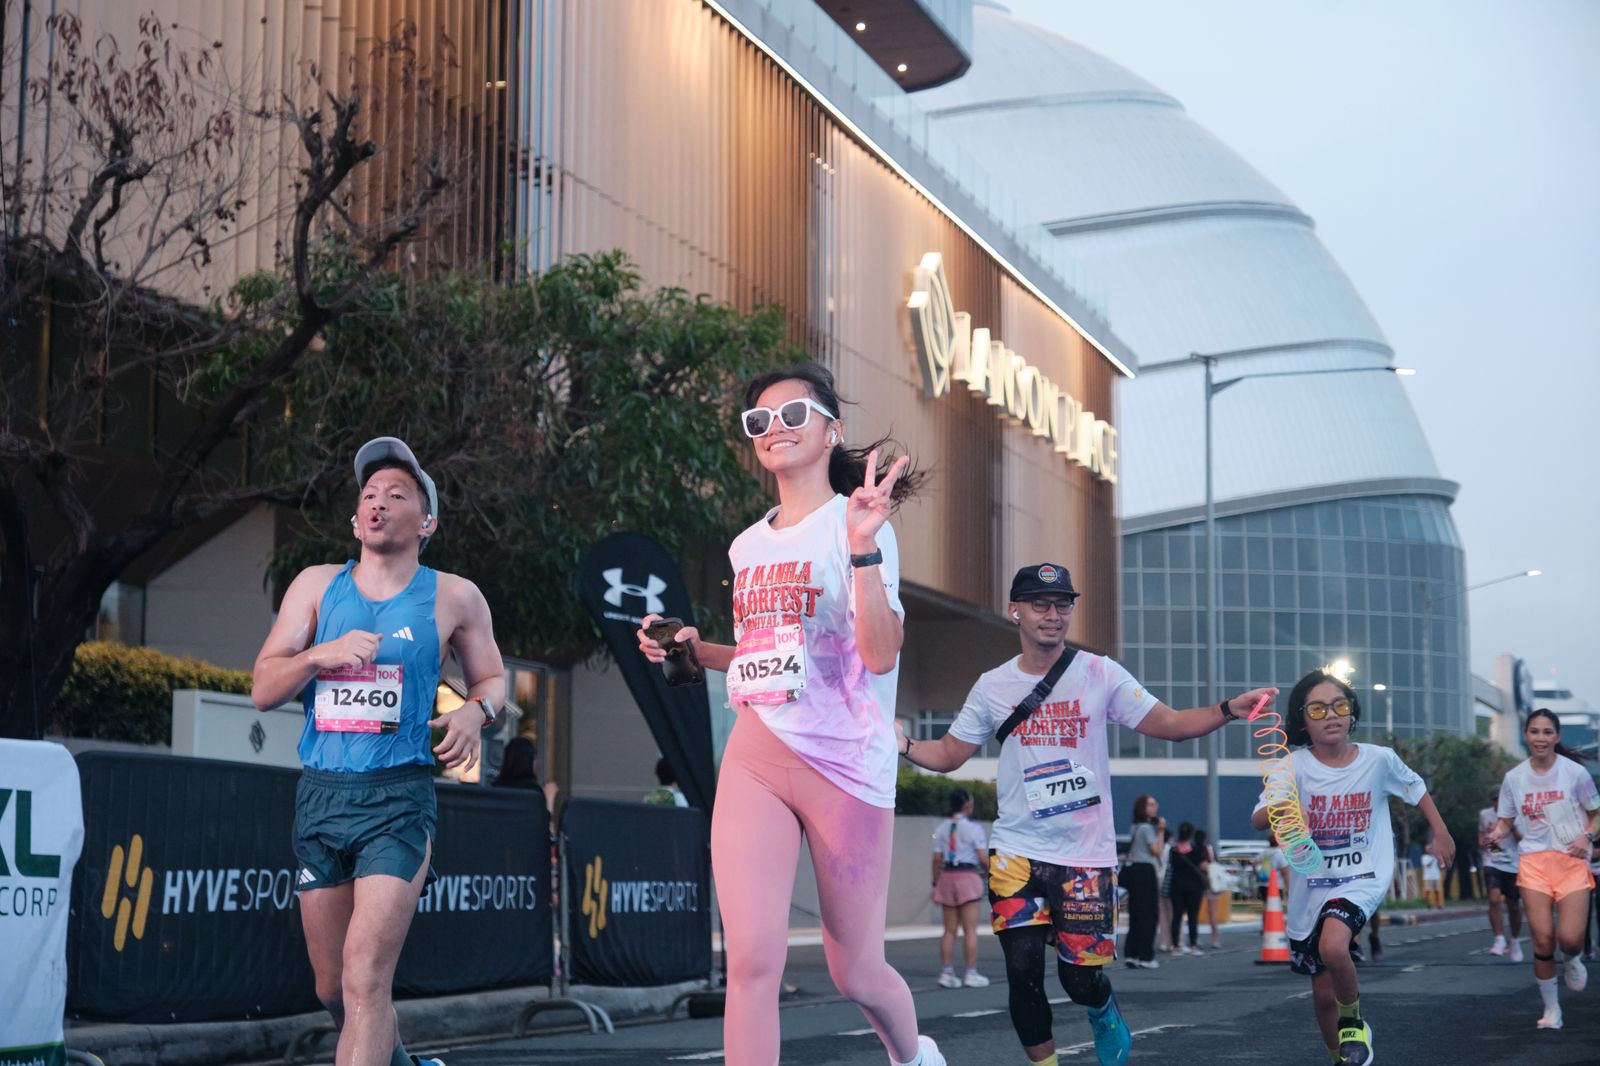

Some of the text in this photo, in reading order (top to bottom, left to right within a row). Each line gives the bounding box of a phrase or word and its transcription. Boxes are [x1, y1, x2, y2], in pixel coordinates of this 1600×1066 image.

[750, 561, 812, 588] MANILA
[776, 632, 797, 643] 10K
[377, 670, 397, 680] 10K
[738, 655, 801, 682] 10524
[331, 688, 398, 708] 12460
[1046, 777, 1087, 797] 7719
[1353, 836, 1365, 844] 5K
[1323, 851, 1363, 869] 7710
[417, 875, 537, 914] HYVESPORTS
[611, 881, 699, 914] HYVESPORTS
[1341, 1030, 1356, 1041] NIKE
